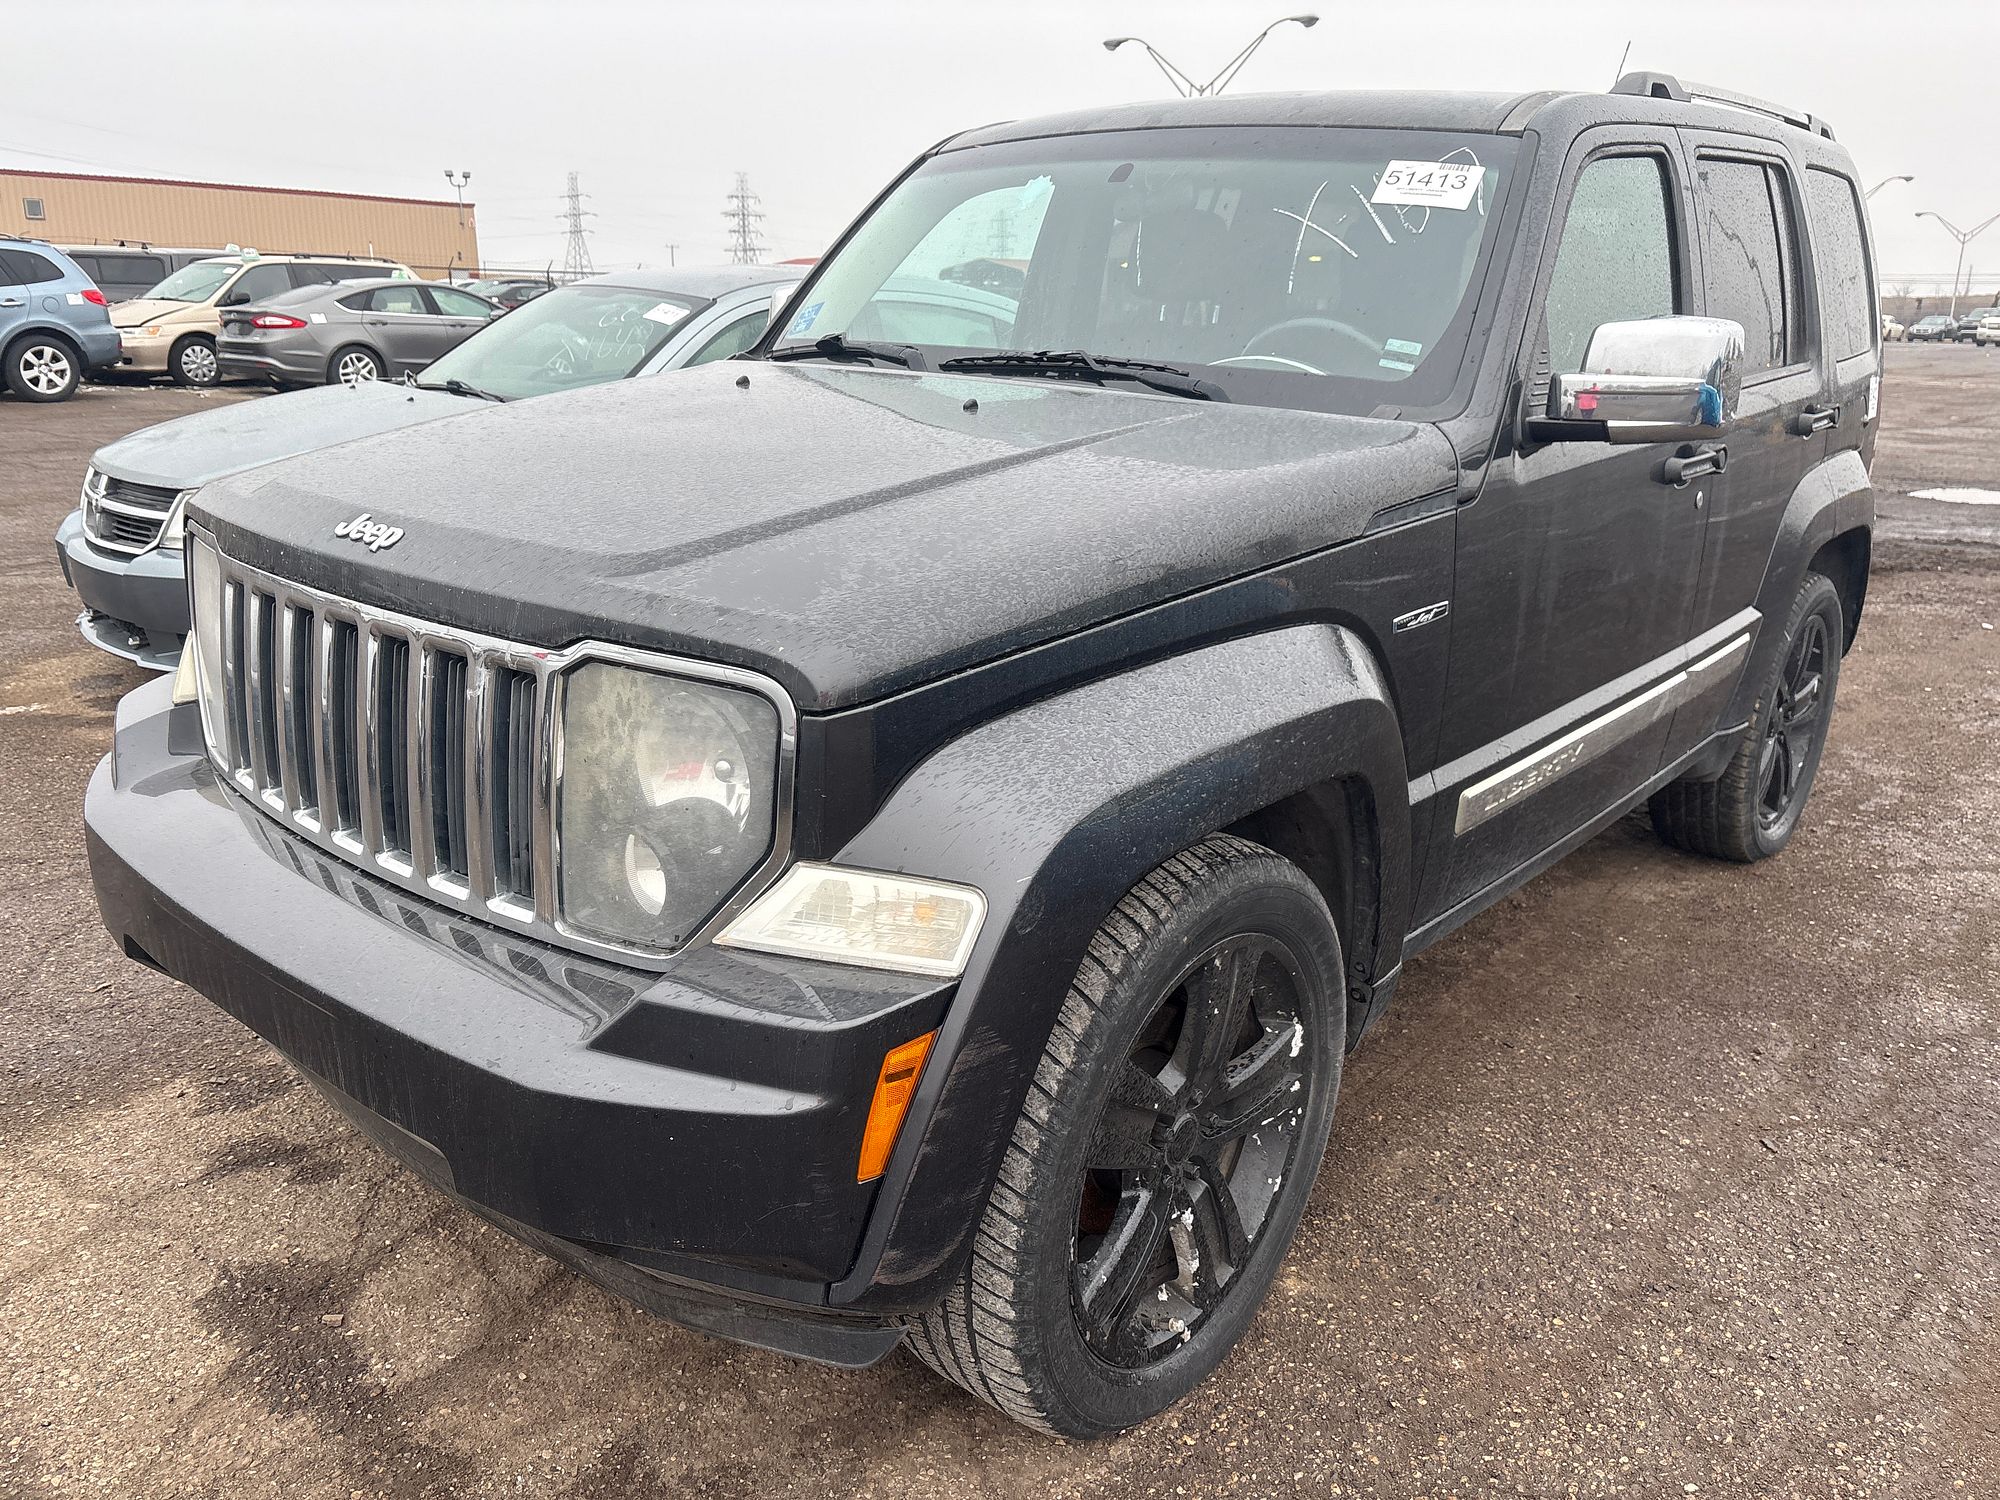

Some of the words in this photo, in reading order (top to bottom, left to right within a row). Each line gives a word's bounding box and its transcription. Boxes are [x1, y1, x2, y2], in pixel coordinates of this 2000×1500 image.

[1385, 170, 1468, 190] 51413
[334, 512, 406, 553] Jeep
[1484, 742, 1584, 812] LIBERTY
